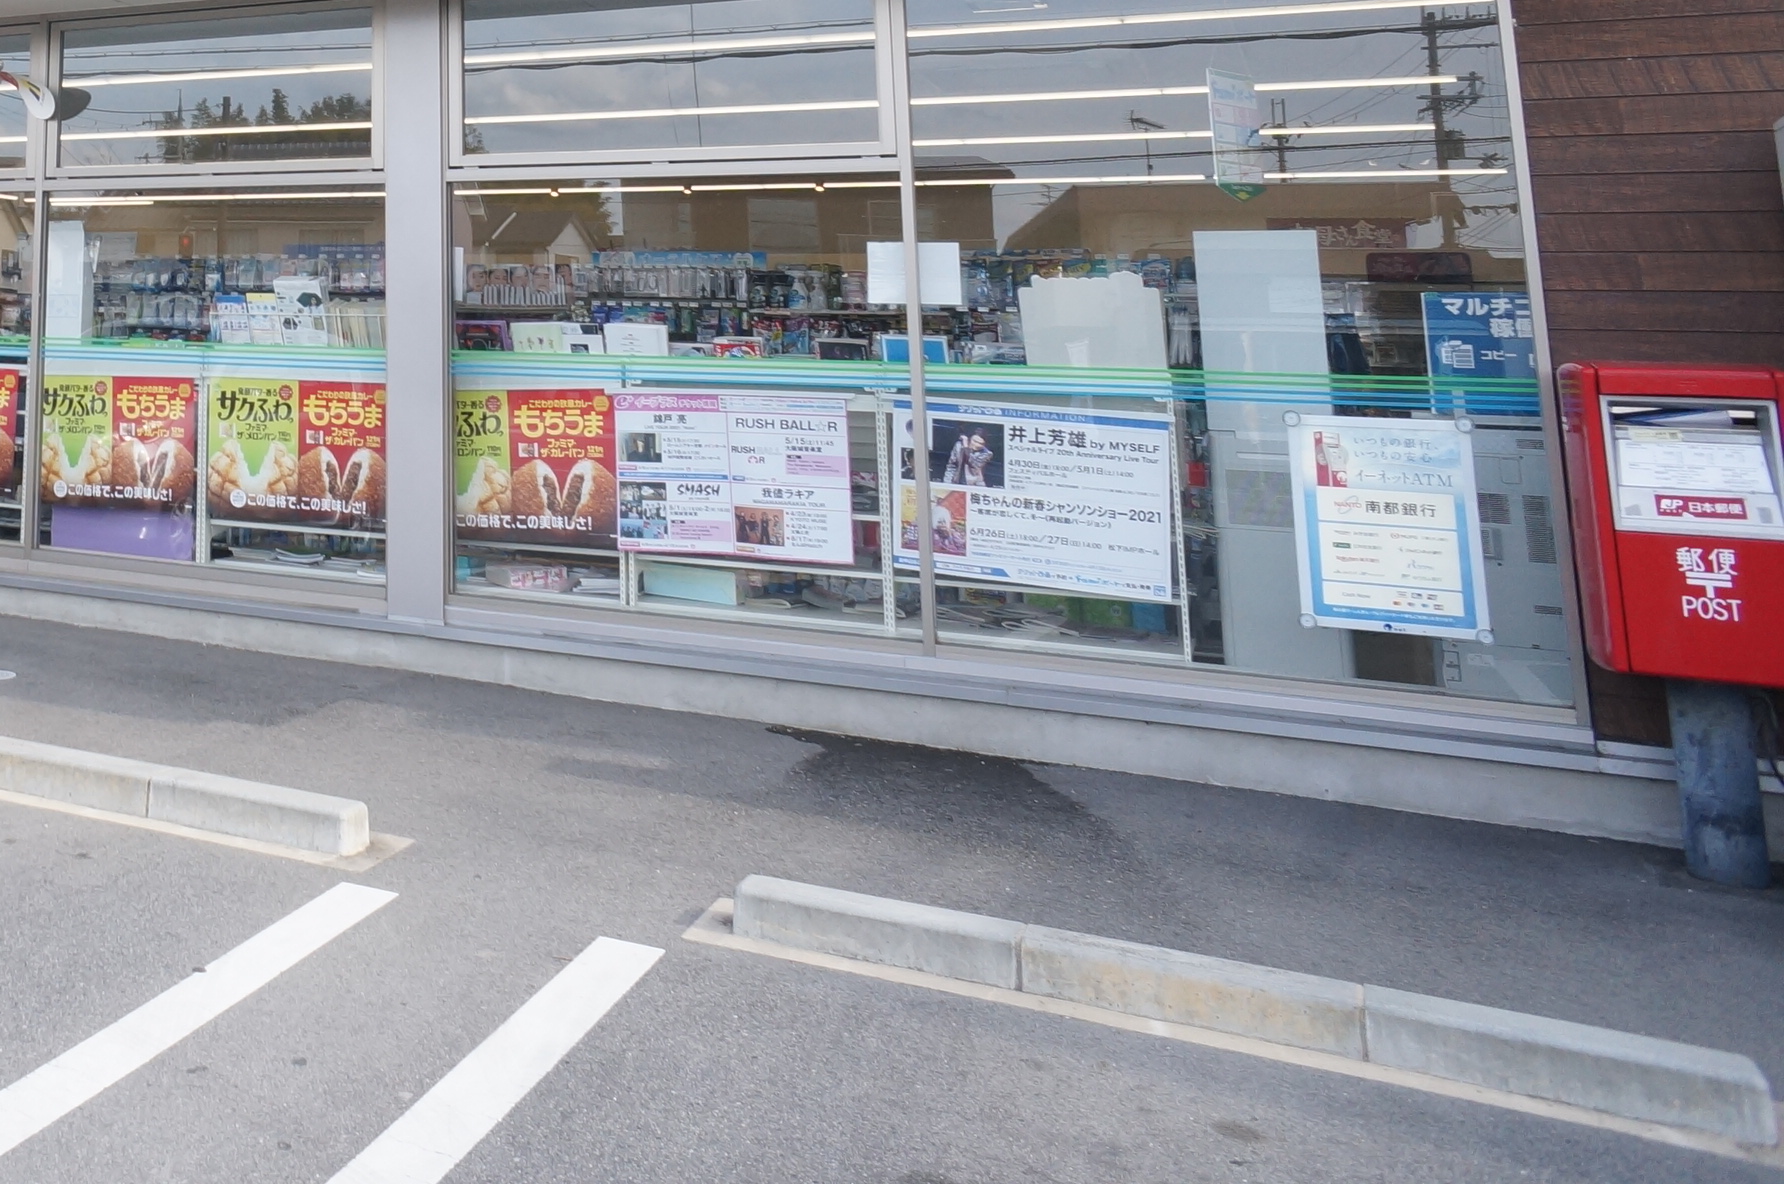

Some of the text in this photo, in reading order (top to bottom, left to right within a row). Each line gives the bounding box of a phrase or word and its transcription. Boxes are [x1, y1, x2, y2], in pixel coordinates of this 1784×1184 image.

[1296, 220, 1393, 247] 母さん食堂
[1480, 350, 1517, 361] コピー
[116, 389, 186, 420] もちうま
[303, 394, 383, 428] もちうま
[456, 411, 504, 438] ふわっ
[513, 404, 604, 439] もちうま
[736, 417, 775, 429] RUSH
[731, 445, 756, 454] RUSH
[1008, 425, 1160, 455] 井上芳雄 by MYSELF
[1056, 448, 1075, 457] 20th
[1076, 450, 1122, 463] Anniversary
[1123, 455, 1142, 463] Live
[1143, 455, 1159, 464] Tour
[1354, 450, 1433, 464] いつもの安心
[1356, 468, 1454, 488] イーネットATM
[677, 483, 720, 496] SMASH
[1333, 500, 1437, 518] NANTO 南都銀行
[1688, 502, 1744, 515] 日本郵便
[1676, 546, 1738, 576] 郵便
[1682, 595, 1742, 622] POST
